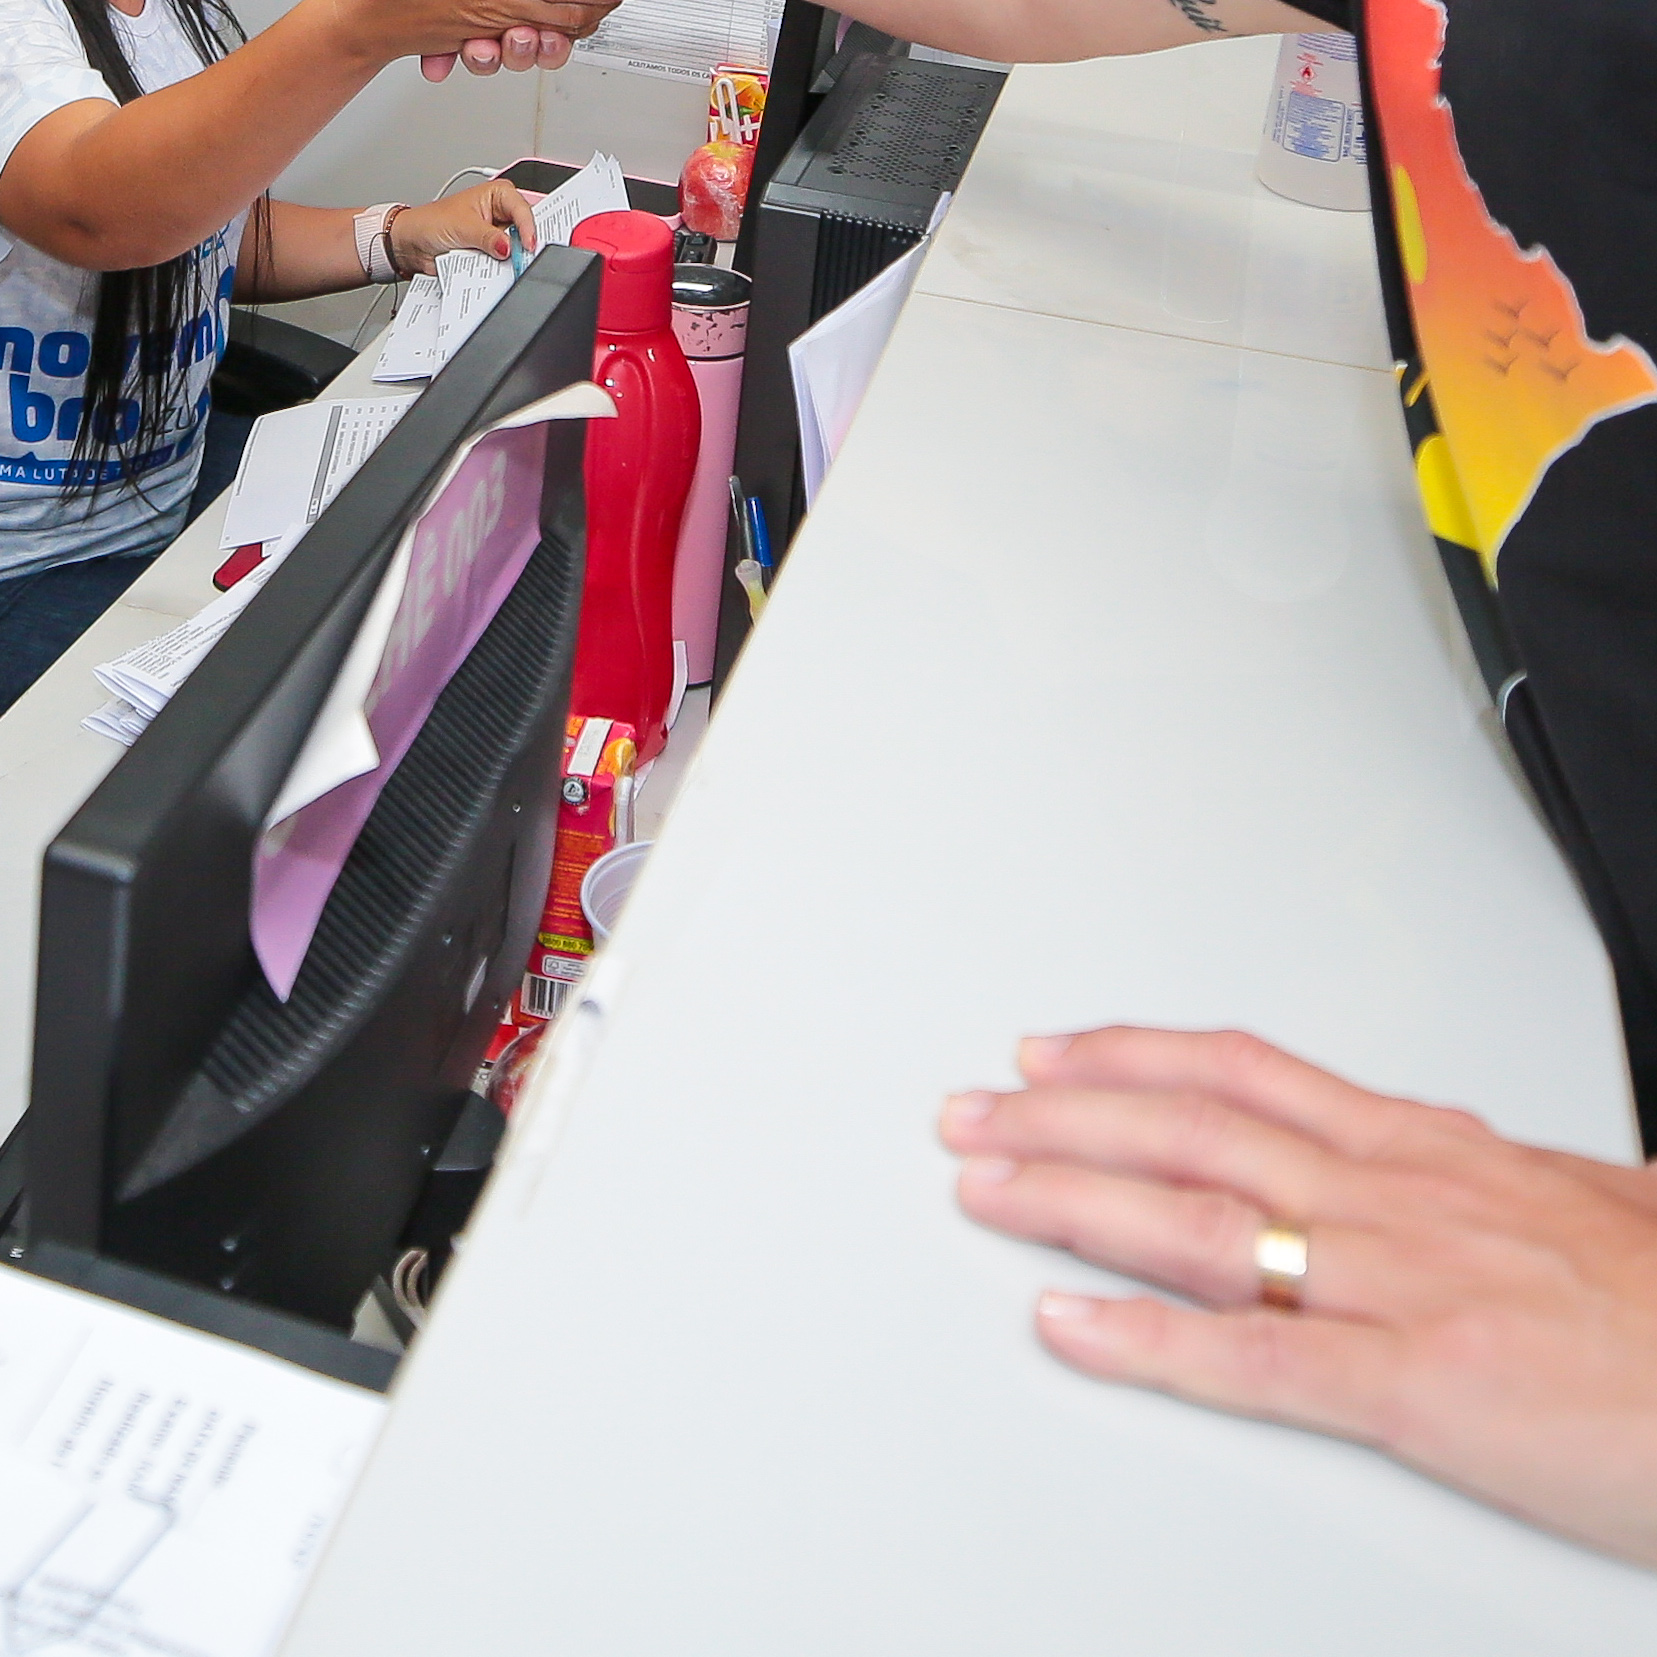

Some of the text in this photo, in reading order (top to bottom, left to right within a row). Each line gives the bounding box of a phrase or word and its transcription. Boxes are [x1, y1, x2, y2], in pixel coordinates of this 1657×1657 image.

[627, 59, 667, 75] ACEITAMOS
[667, 66, 691, 77] TODOS
[691, 69, 702, 78] OS
